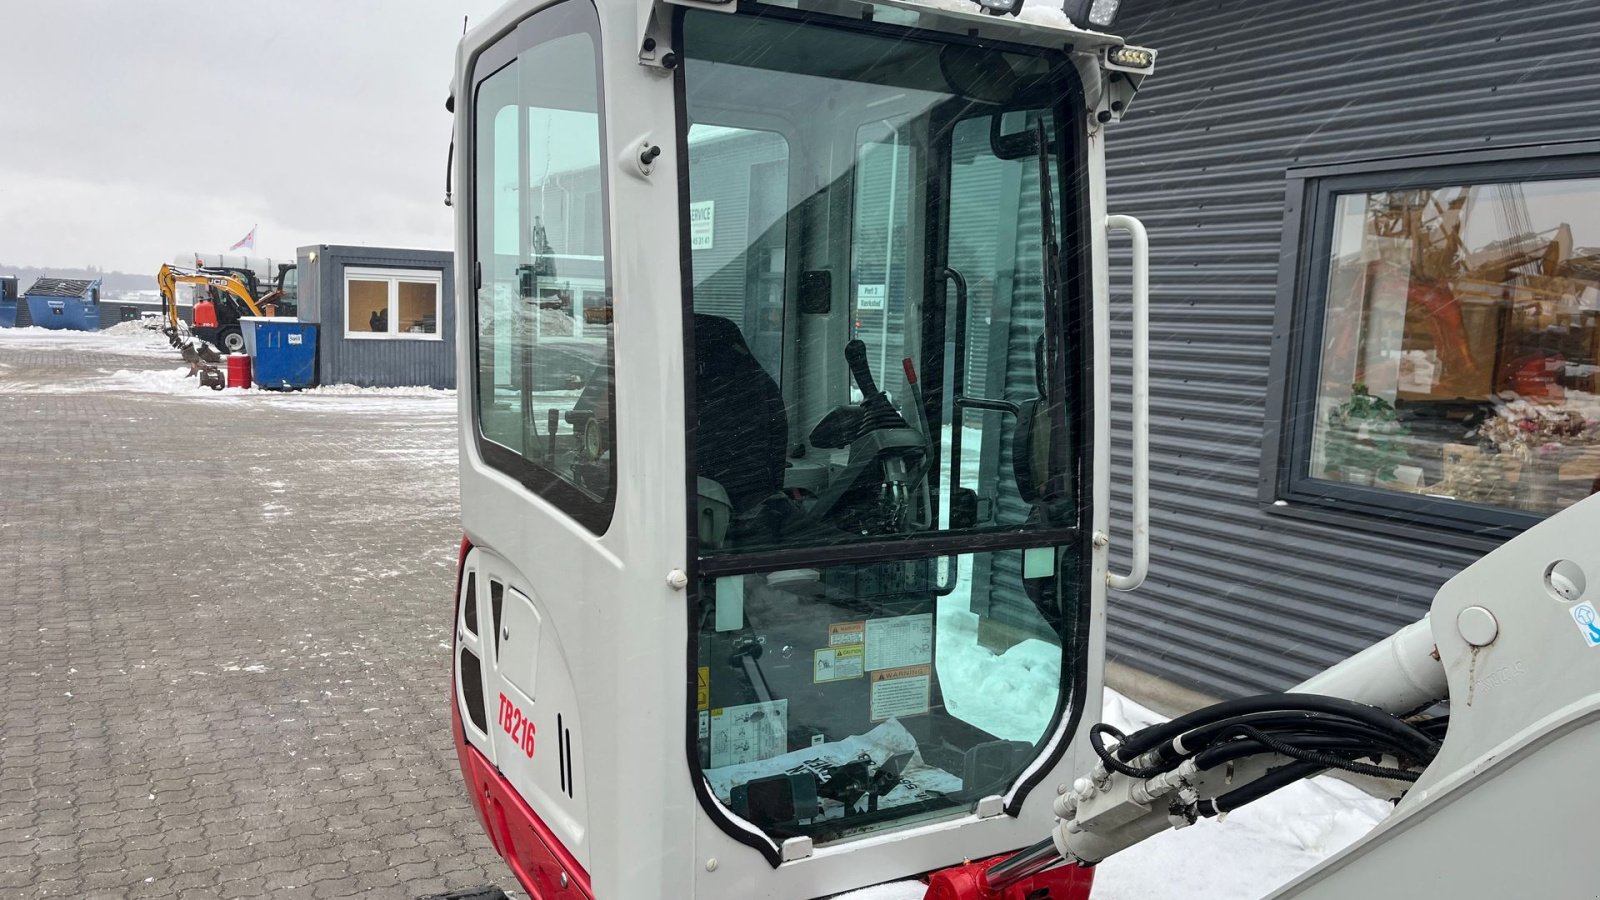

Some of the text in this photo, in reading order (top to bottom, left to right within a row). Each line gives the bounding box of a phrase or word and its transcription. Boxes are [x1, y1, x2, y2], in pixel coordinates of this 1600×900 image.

[691, 207, 711, 221] ERVICE
[208, 278, 228, 286] JCB
[842, 648, 862, 656] CAUTION
[886, 668, 923, 679] WARNING
[499, 691, 536, 759] TB216
